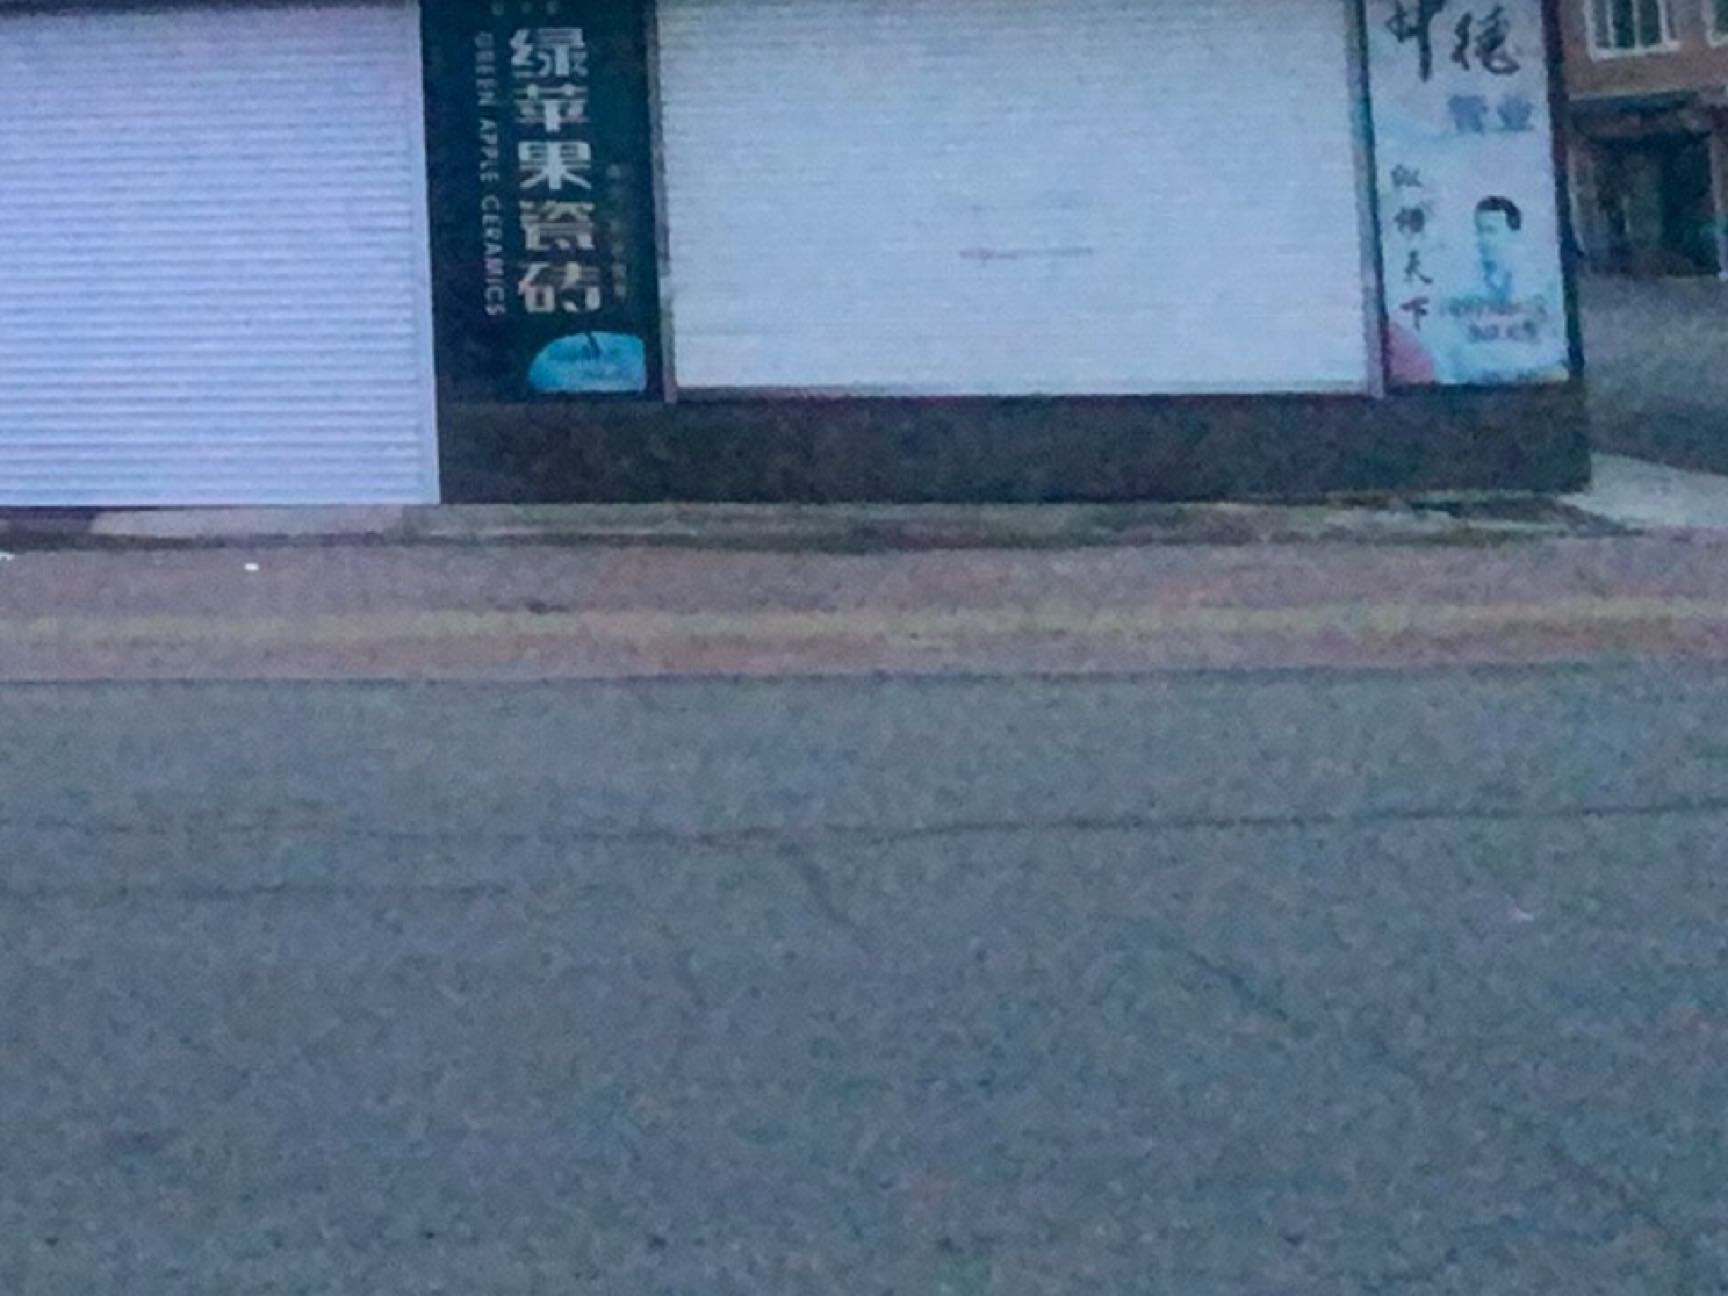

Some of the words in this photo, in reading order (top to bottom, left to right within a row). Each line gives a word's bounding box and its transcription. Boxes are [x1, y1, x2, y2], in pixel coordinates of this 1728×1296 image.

[475, 31, 496, 106] GREEN
[479, 120, 500, 183] APPLE
[510, 27, 601, 313] 绿苹果瓷砖
[481, 195, 505, 315] CERAMICS
